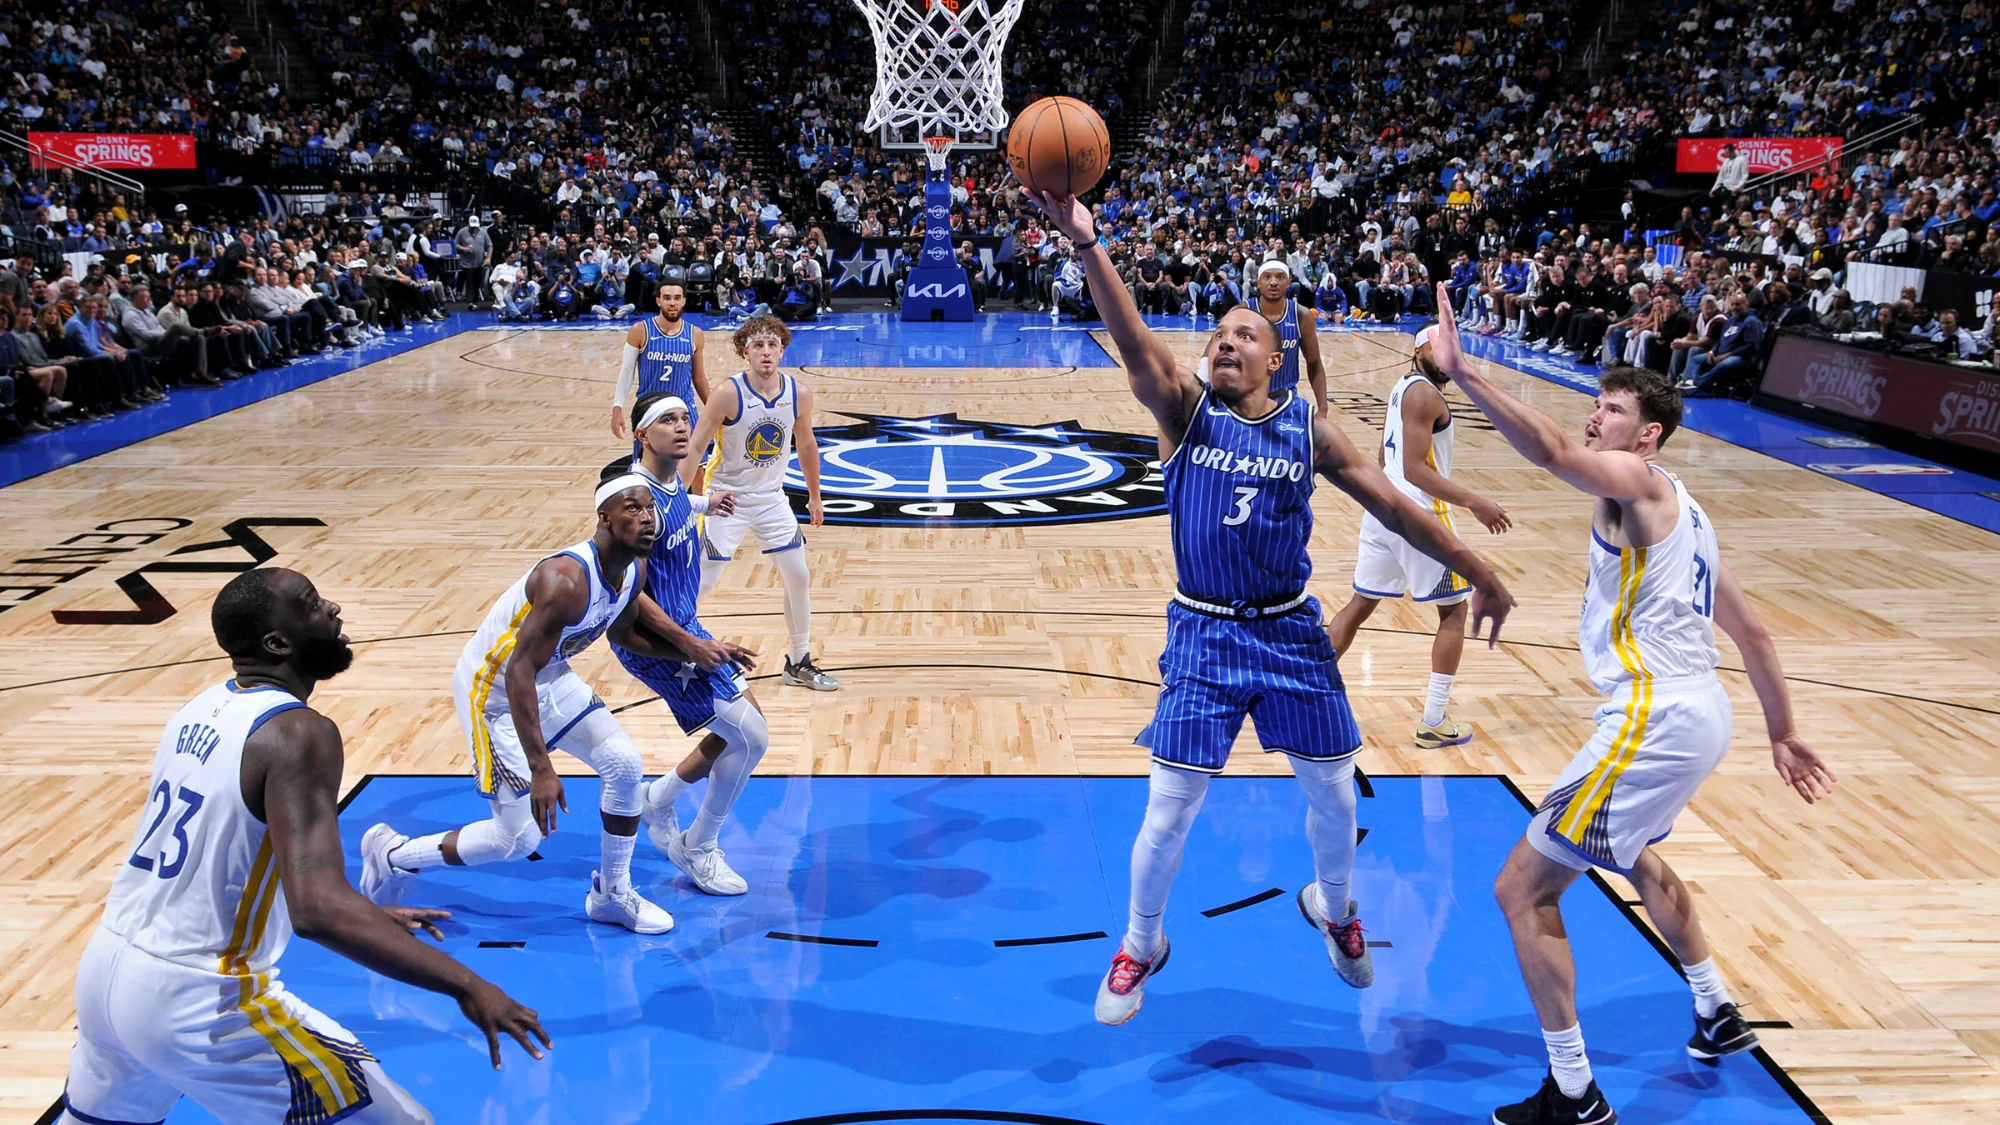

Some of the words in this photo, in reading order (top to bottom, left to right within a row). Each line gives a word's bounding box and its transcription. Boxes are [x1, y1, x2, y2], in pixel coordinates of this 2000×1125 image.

[96, 136, 129, 144] DISNEY
[1739, 140, 1771, 149] DISNEY
[75, 144, 153, 167] SPRINGS
[1717, 148, 1793, 170] SRINGS
[908, 283, 966, 298] KIA
[647, 351, 691, 363] ORLANDO
[1831, 352, 1869, 370] DISNEY
[659, 365, 673, 381] 2
[1798, 361, 1888, 417] SPRINGS
[747, 416, 771, 431] GOLDEN
[773, 417, 787, 430] STATE
[1276, 421, 1305, 435] Disney
[772, 431, 780, 443] 2
[743, 452, 783, 469] WARRIORS
[1191, 444, 1305, 483] ORLANDO
[1222, 486, 1259, 526] 3
[51, 517, 328, 625] KIA
[1692, 552, 1712, 618] 21
[176, 723, 221, 766] GREEN
[128, 779, 205, 880] 23
